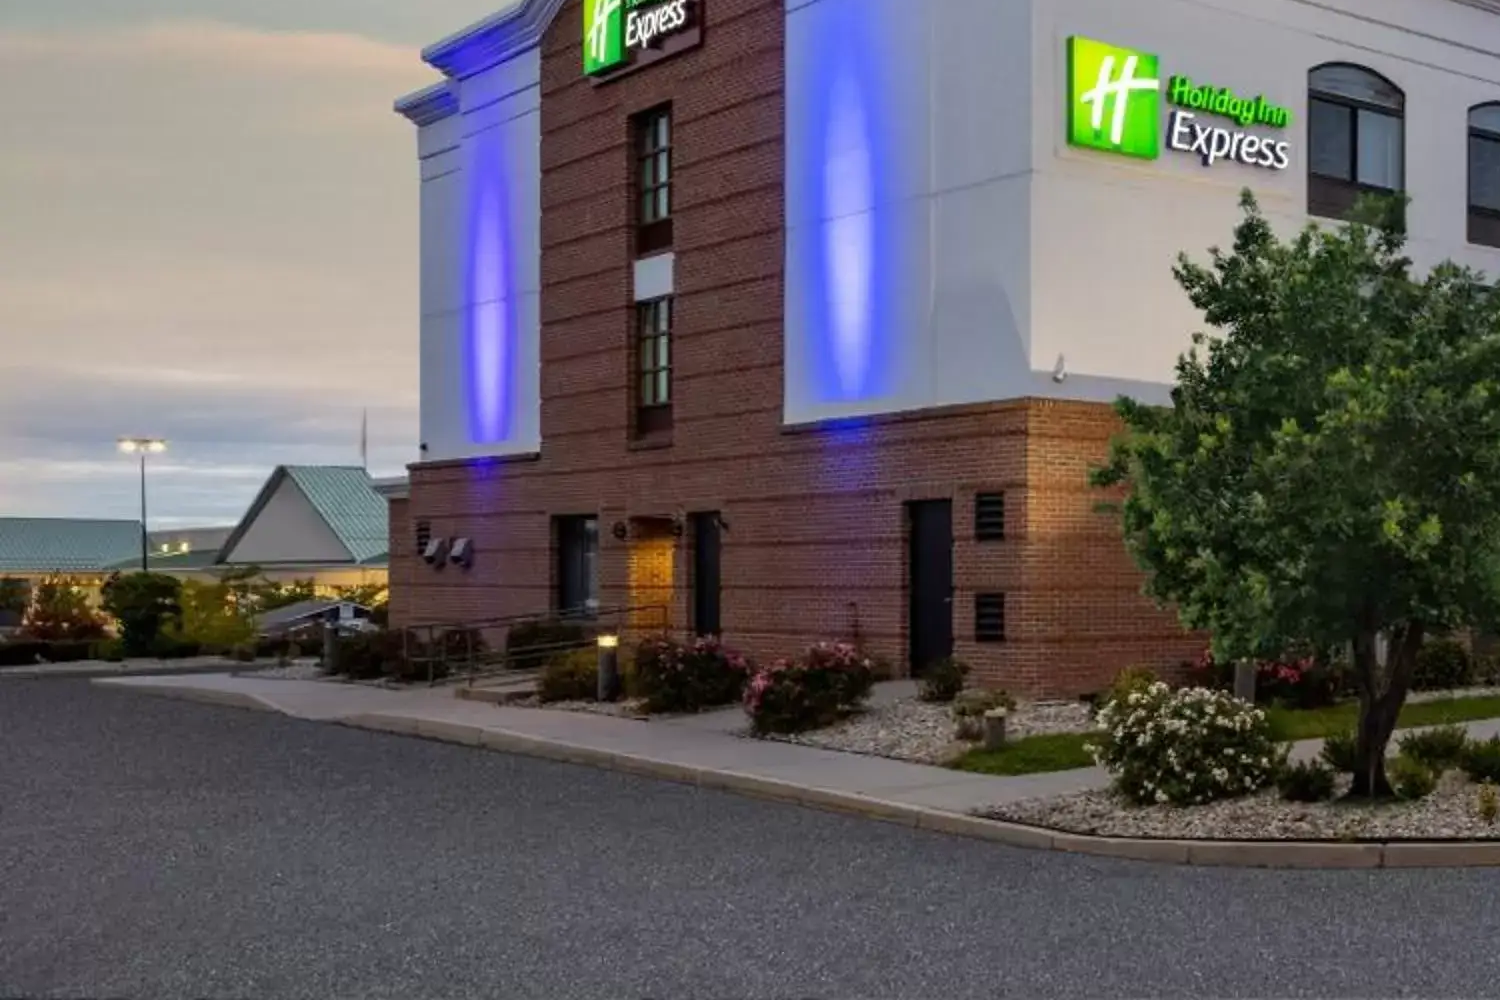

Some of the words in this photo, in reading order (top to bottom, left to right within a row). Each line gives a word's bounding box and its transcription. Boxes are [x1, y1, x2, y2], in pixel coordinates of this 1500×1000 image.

[1171, 75, 1255, 125] Holiday
[1258, 93, 1291, 126] Inn
[1171, 110, 1291, 170] Express
